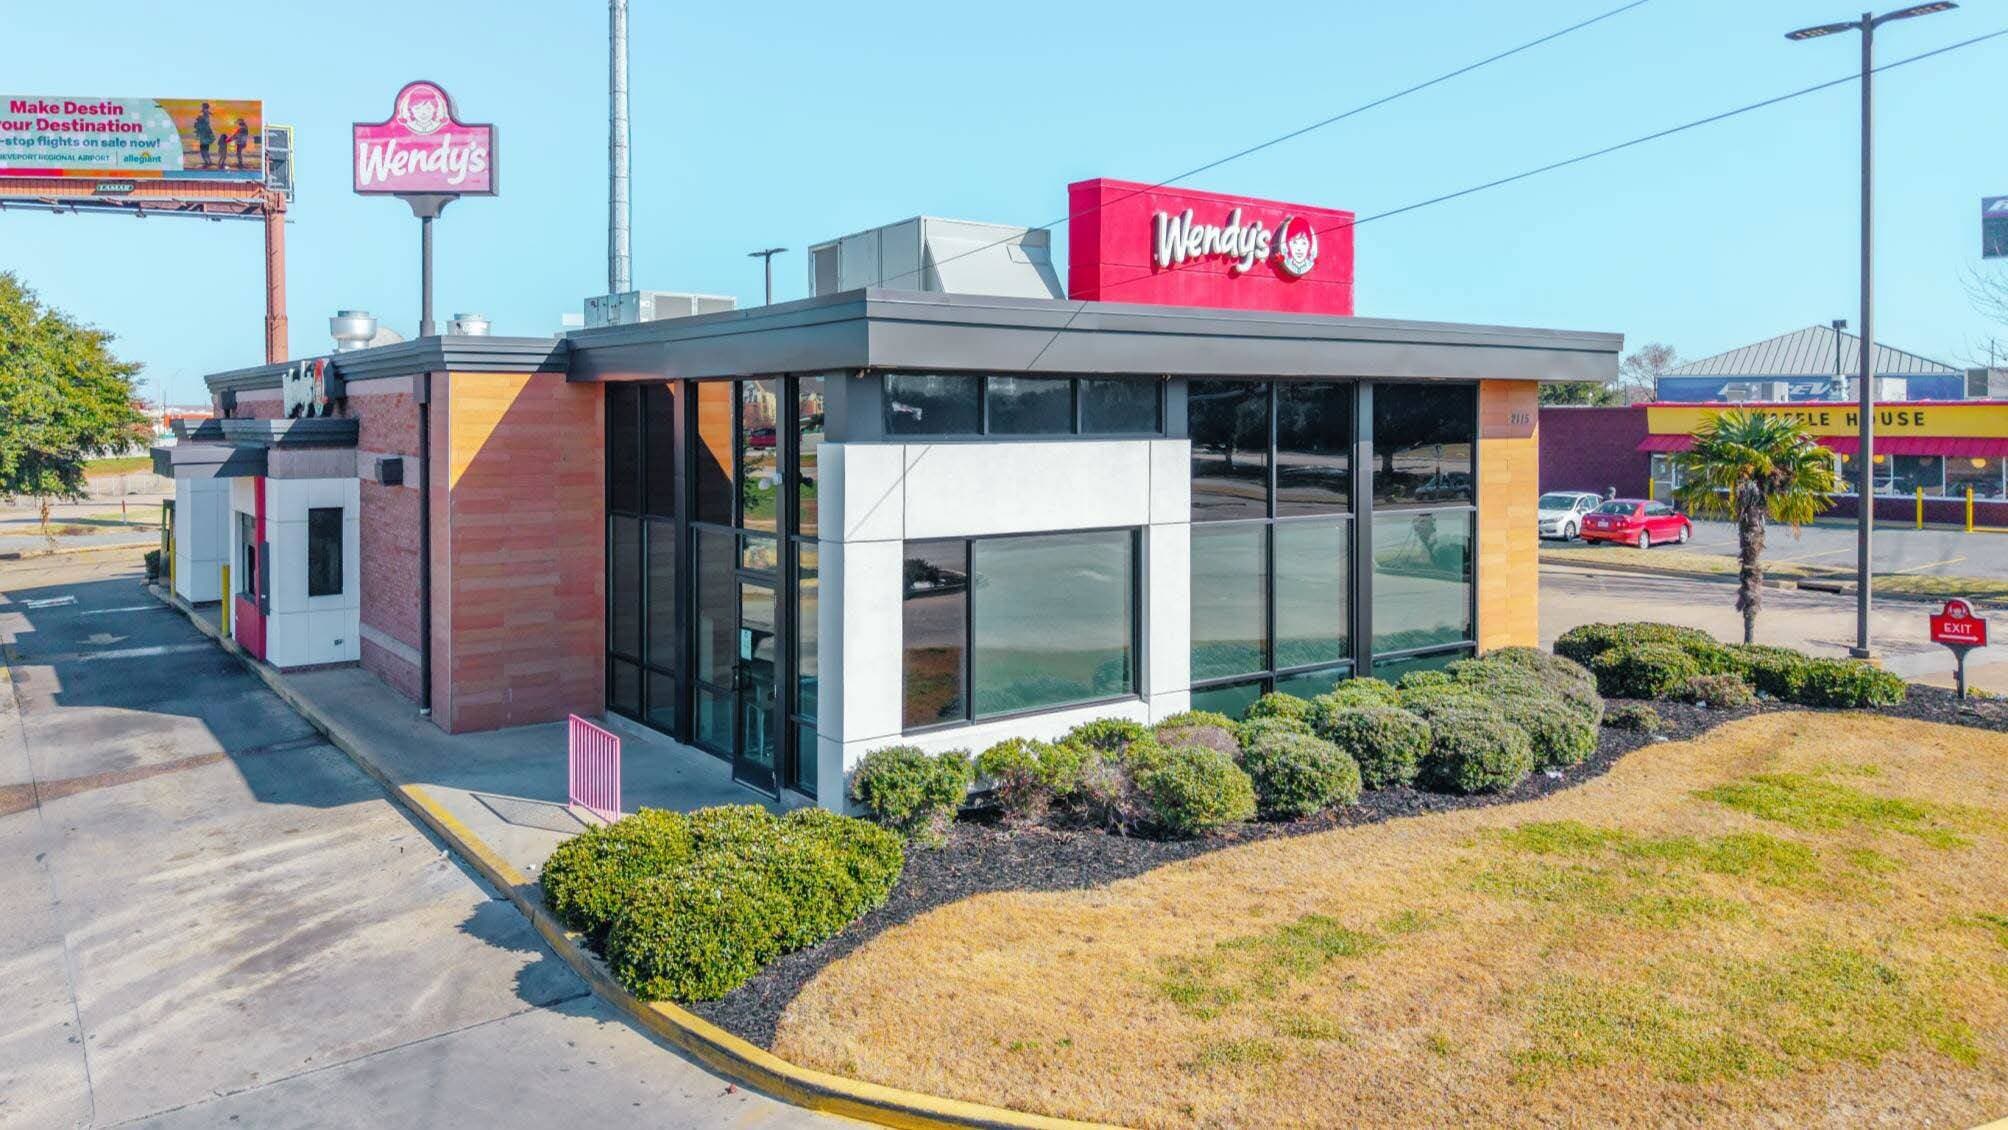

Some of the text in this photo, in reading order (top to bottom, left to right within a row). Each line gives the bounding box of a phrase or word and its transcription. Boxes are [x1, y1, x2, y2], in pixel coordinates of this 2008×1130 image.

[10, 100, 124, 115] Make Destin
[0, 118, 143, 133] our Destination
[37, 136, 80, 149] flights
[82, 139, 99, 148] on
[100, 138, 127, 148] sale
[129, 139, 160, 149] now!
[77, 154, 110, 162] AIRPORT
[123, 154, 162, 164] allegiant
[359, 133, 488, 186] Wendy's
[1155, 207, 1271, 273] Wendy's
[1846, 411, 1925, 426] HUSE
[1943, 622, 1972, 634] EXIT
